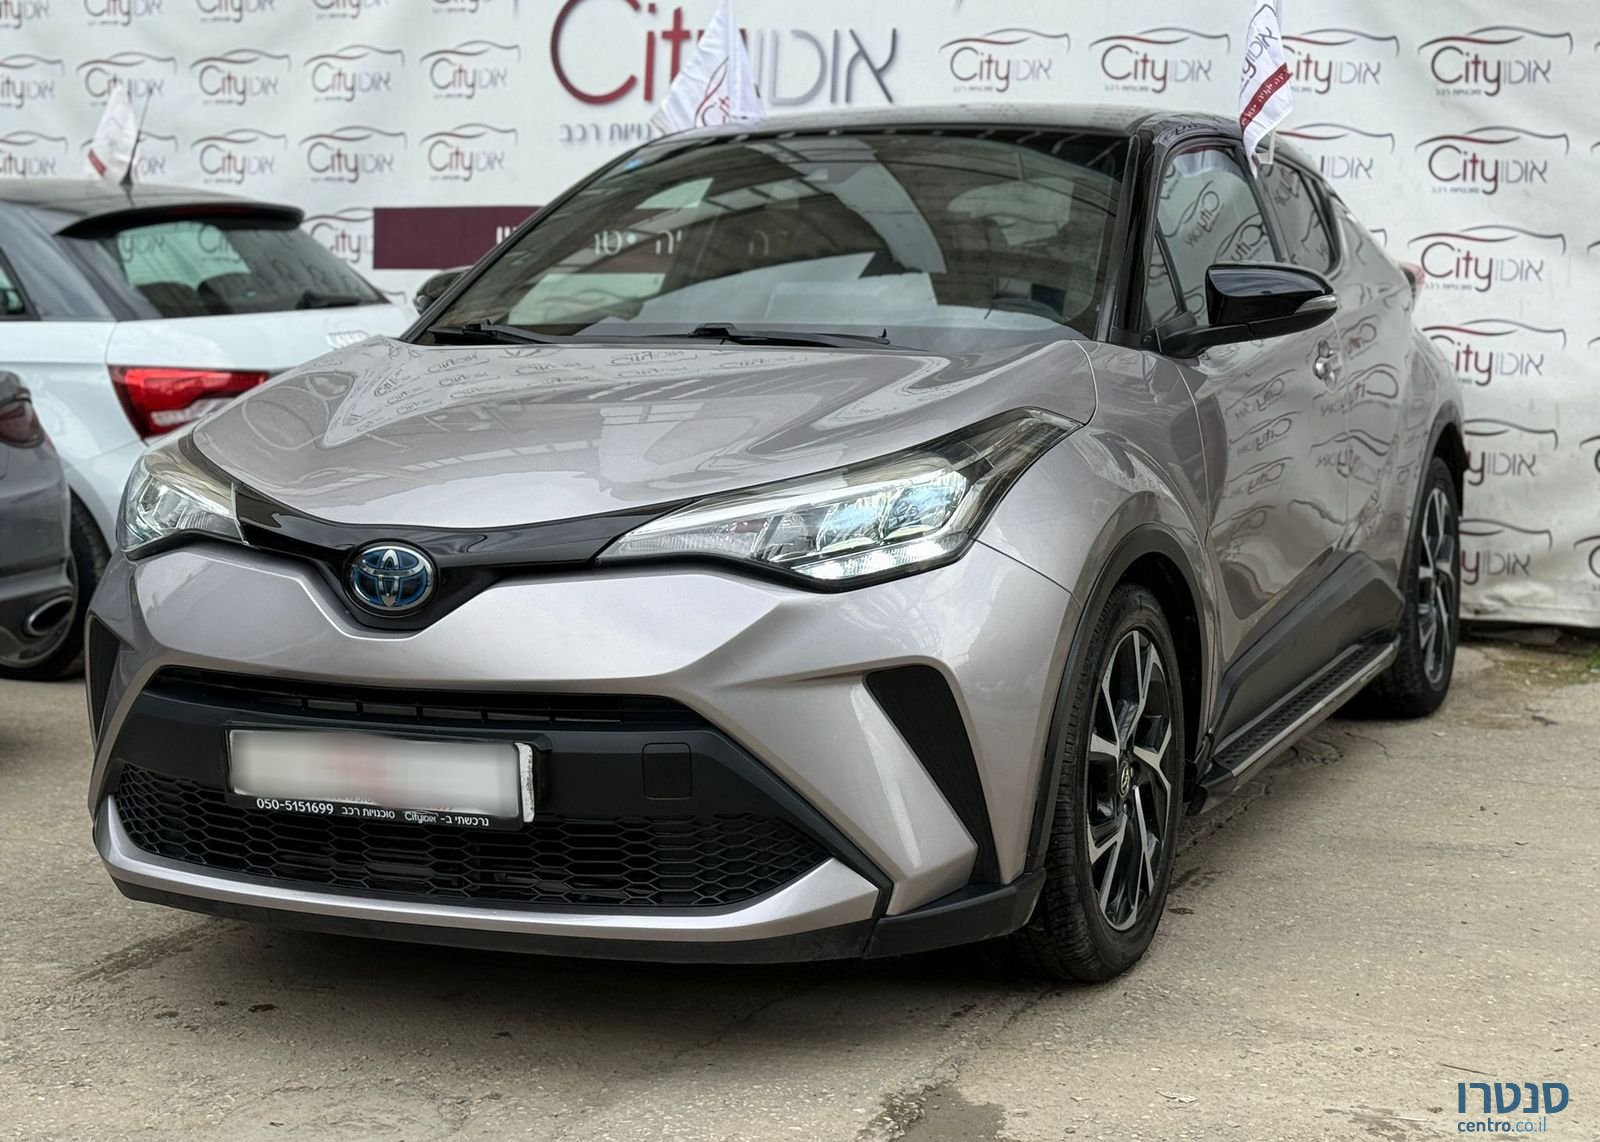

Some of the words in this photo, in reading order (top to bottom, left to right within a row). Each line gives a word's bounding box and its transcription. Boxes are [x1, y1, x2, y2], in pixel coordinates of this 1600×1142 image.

[950, 45, 1010, 93] City
[1100, 44, 1167, 94] City
[1430, 45, 1501, 97] City
[1428, 144, 1499, 196] City
[1421, 241, 1493, 293] City
[256, 798, 334, 815] 050-5151699
[341, 806, 360, 816] רכב
